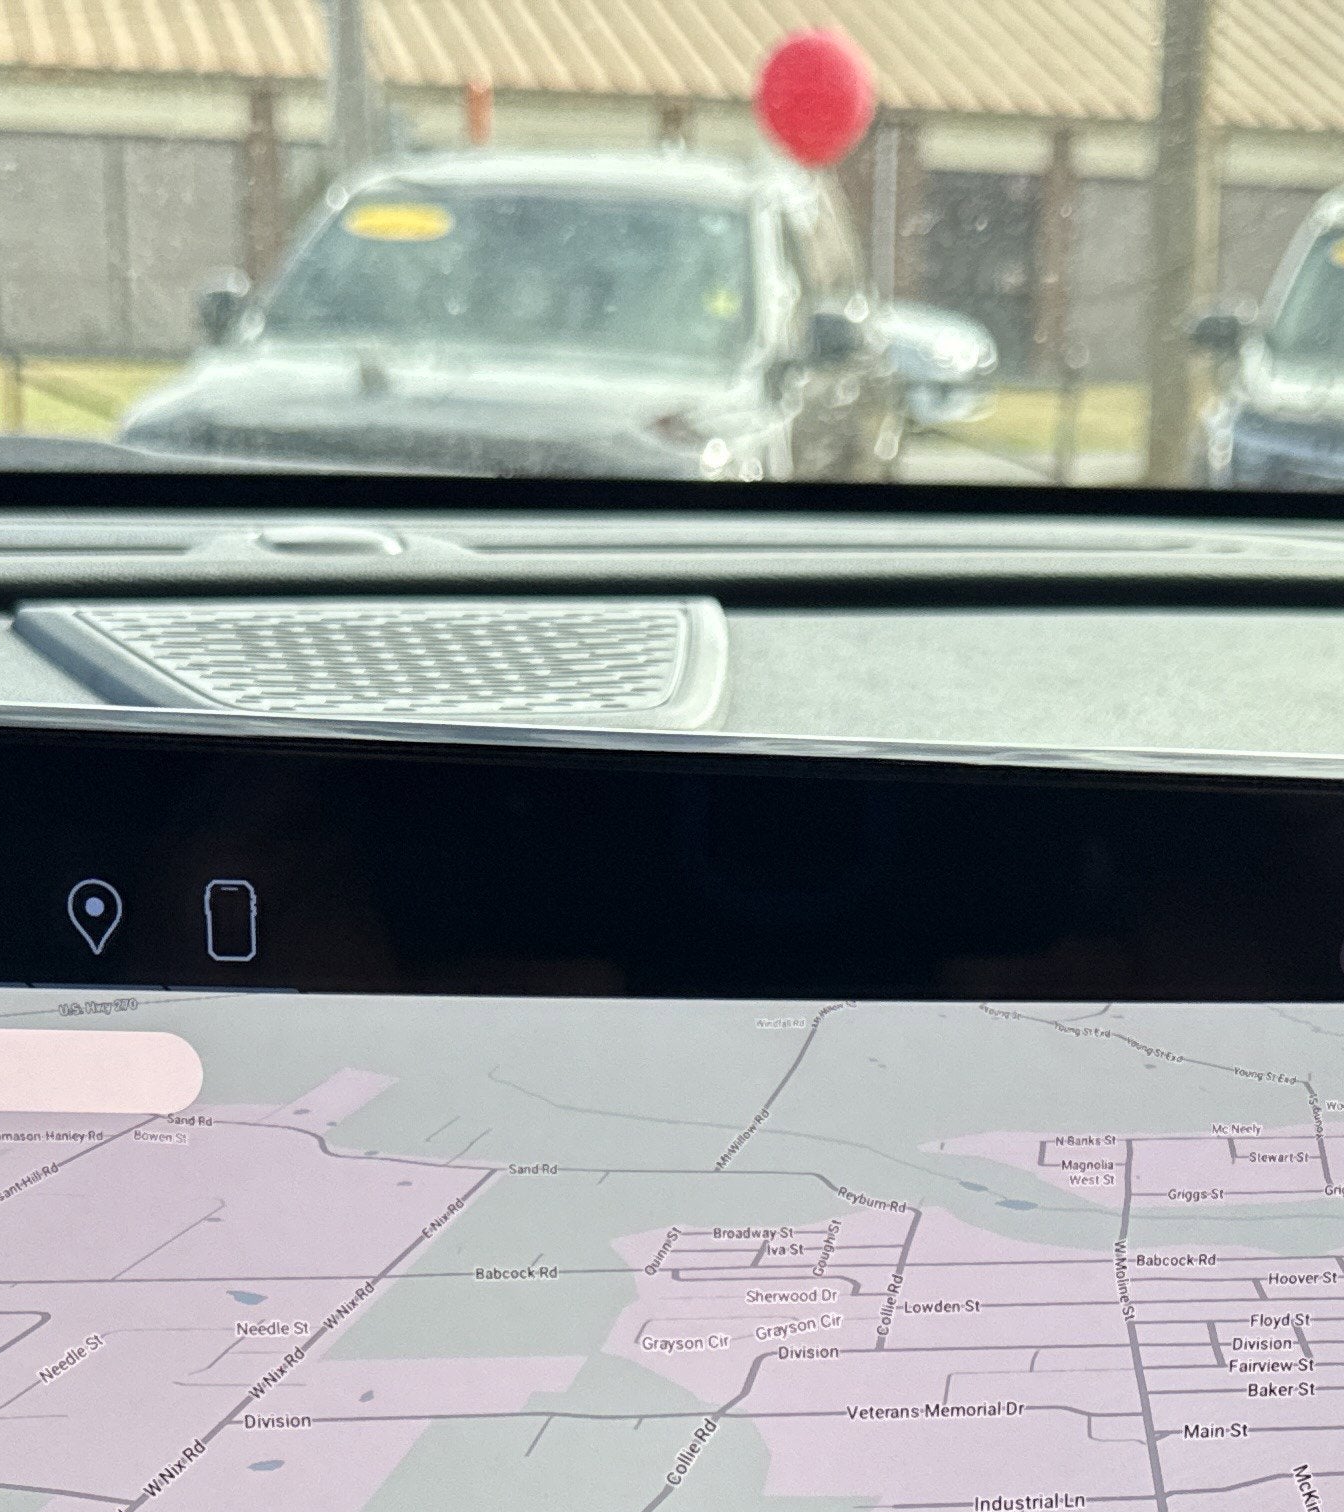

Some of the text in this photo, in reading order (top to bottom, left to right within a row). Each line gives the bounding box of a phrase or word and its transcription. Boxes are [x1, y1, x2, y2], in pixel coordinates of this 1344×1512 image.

[1056, 1135, 1116, 1146] N Banks St
[1249, 1152, 1309, 1163] Stewart St
[509, 1163, 558, 1175] Sand Rd
[1061, 1159, 1114, 1173] Magnolia
[888, 1200, 907, 1214] Rd
[713, 1227, 794, 1242] Broadway St
[644, 1226, 682, 1276] Quinn St
[1136, 1254, 1217, 1267] Babcock Rd
[475, 1266, 558, 1281] Babcock Rd
[1268, 1272, 1338, 1285] Hoover St
[904, 1300, 981, 1313] Lowden St
[236, 1321, 309, 1336] Needle St
[1250, 1314, 1310, 1329] Floyd St
[643, 1335, 728, 1353] Grayson Cir
[1232, 1338, 1292, 1350] Division
[778, 1345, 839, 1359] Division
[1229, 1358, 1314, 1373] Fairview St
[1248, 1382, 1315, 1397] Baker St
[846, 1402, 1025, 1420] Veterans Memorial Dr
[244, 1414, 311, 1429] Division
[1184, 1423, 1248, 1439] Main St
[666, 1418, 718, 1487] Collie Rd
[974, 1494, 1085, 1511] Industrial Ln
